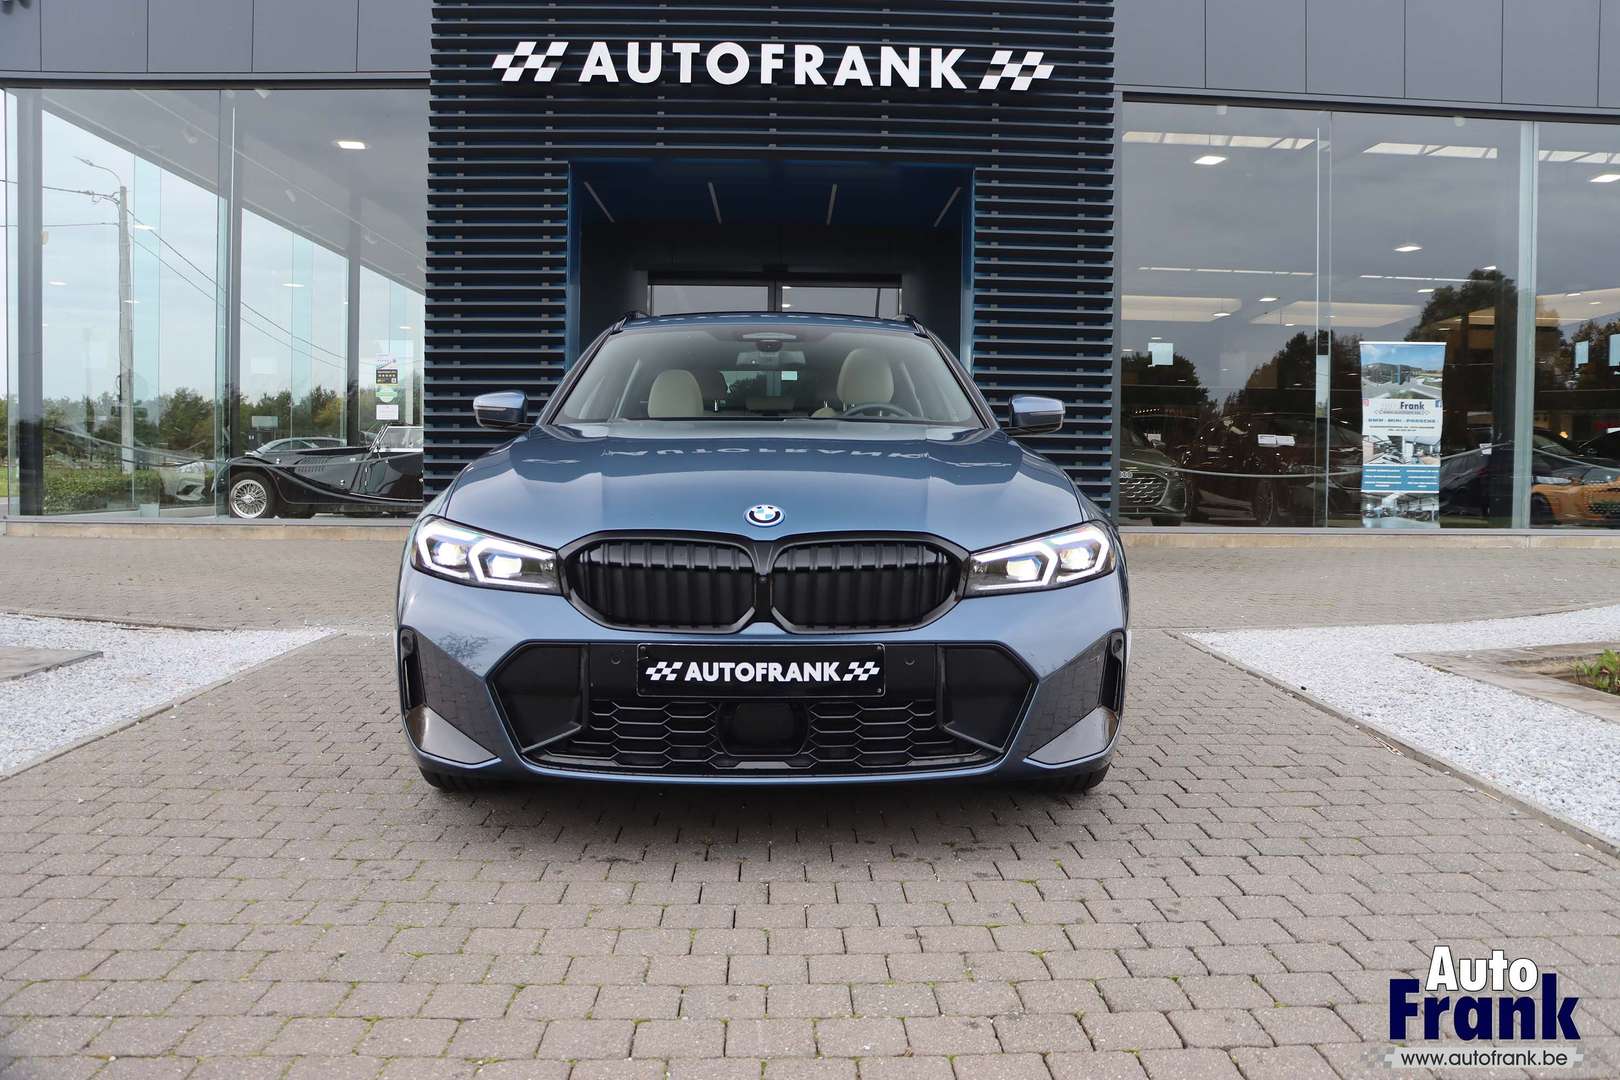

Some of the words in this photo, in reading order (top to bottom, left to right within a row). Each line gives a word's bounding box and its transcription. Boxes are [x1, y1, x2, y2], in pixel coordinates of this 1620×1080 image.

[578, 41, 967, 89] AUTOFRANK
[1400, 401, 1425, 410] Frank
[684, 661, 841, 682] AUTOFRANK
